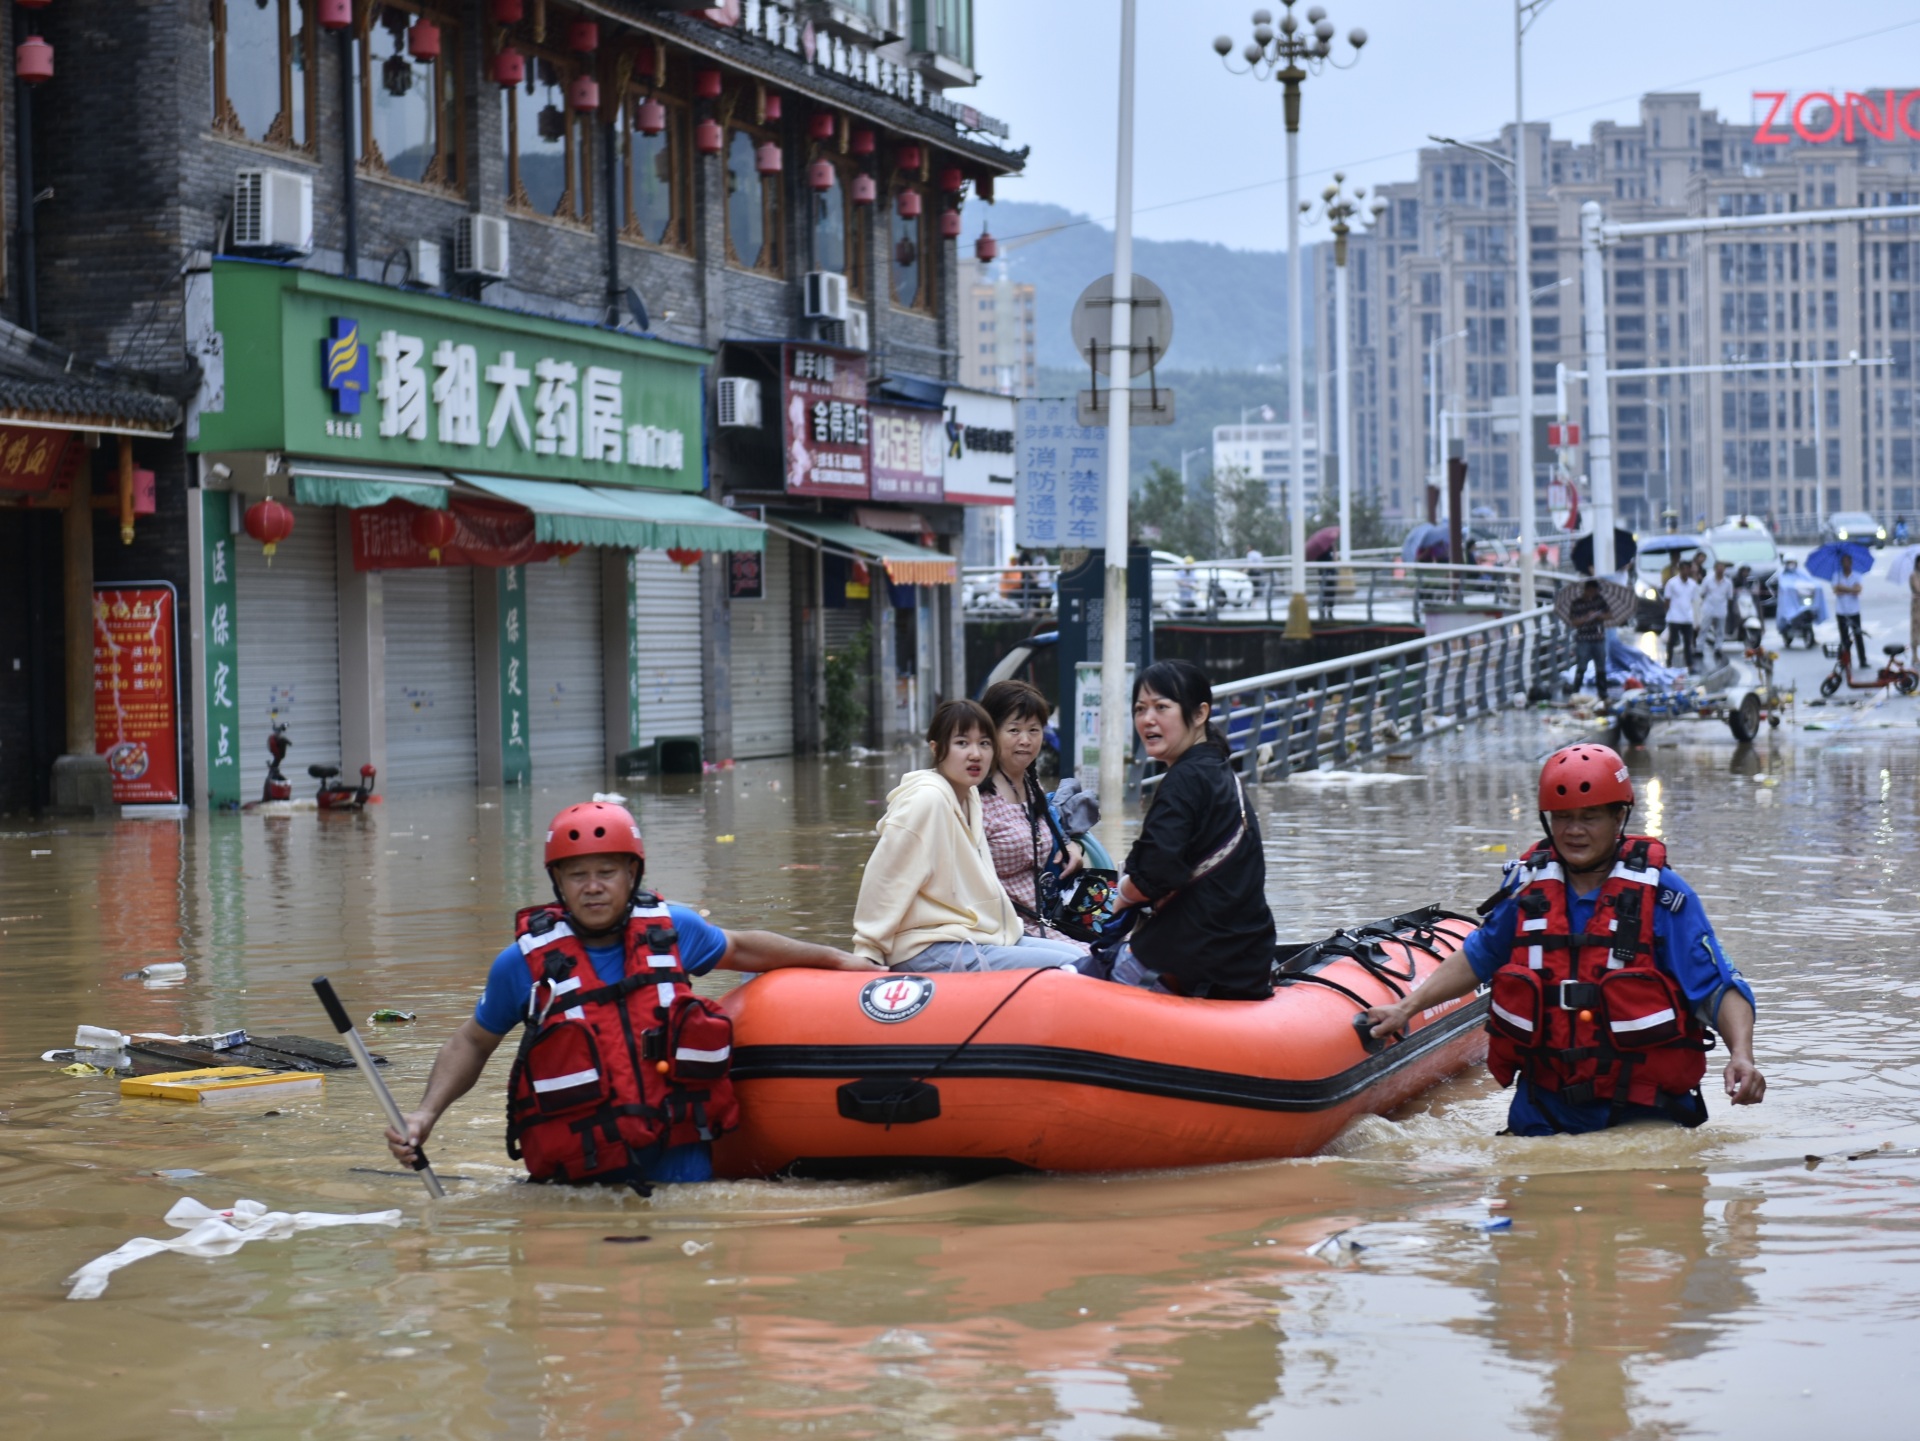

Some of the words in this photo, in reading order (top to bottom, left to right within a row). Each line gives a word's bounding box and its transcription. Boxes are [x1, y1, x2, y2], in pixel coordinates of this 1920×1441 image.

[376, 330, 622, 462] 扬祖大药房
[1024, 425, 1105, 440] 步步高大酒店
[1027, 447, 1056, 540] 消防通道
[1067, 447, 1099, 540] 严禁停车
[211, 540, 232, 765] 医保定点
[864, 1001, 921, 1019] HAISHANGPIAO
